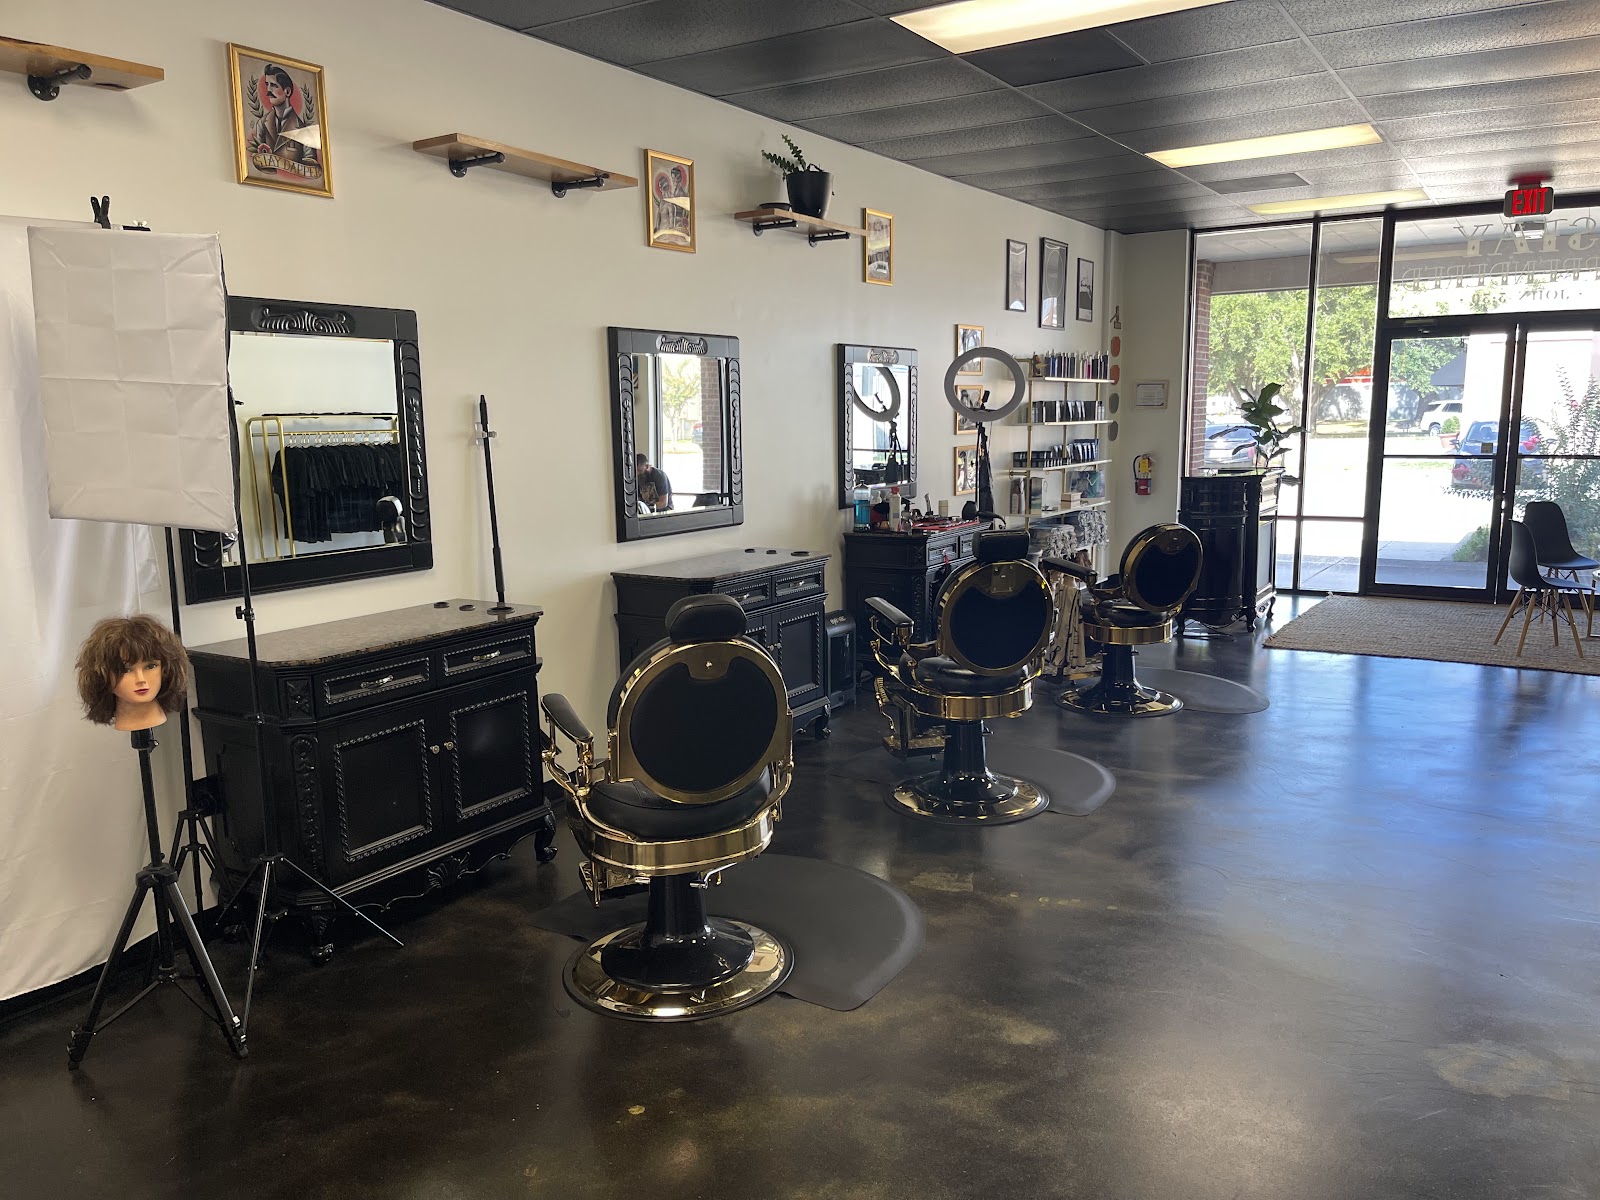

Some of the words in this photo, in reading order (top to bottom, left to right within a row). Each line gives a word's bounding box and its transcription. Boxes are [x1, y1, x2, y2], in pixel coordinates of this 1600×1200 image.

[254, 153, 281, 167] STAY
[283, 158, 322, 178] DAPPER
[1512, 188, 1548, 215] EXIT
